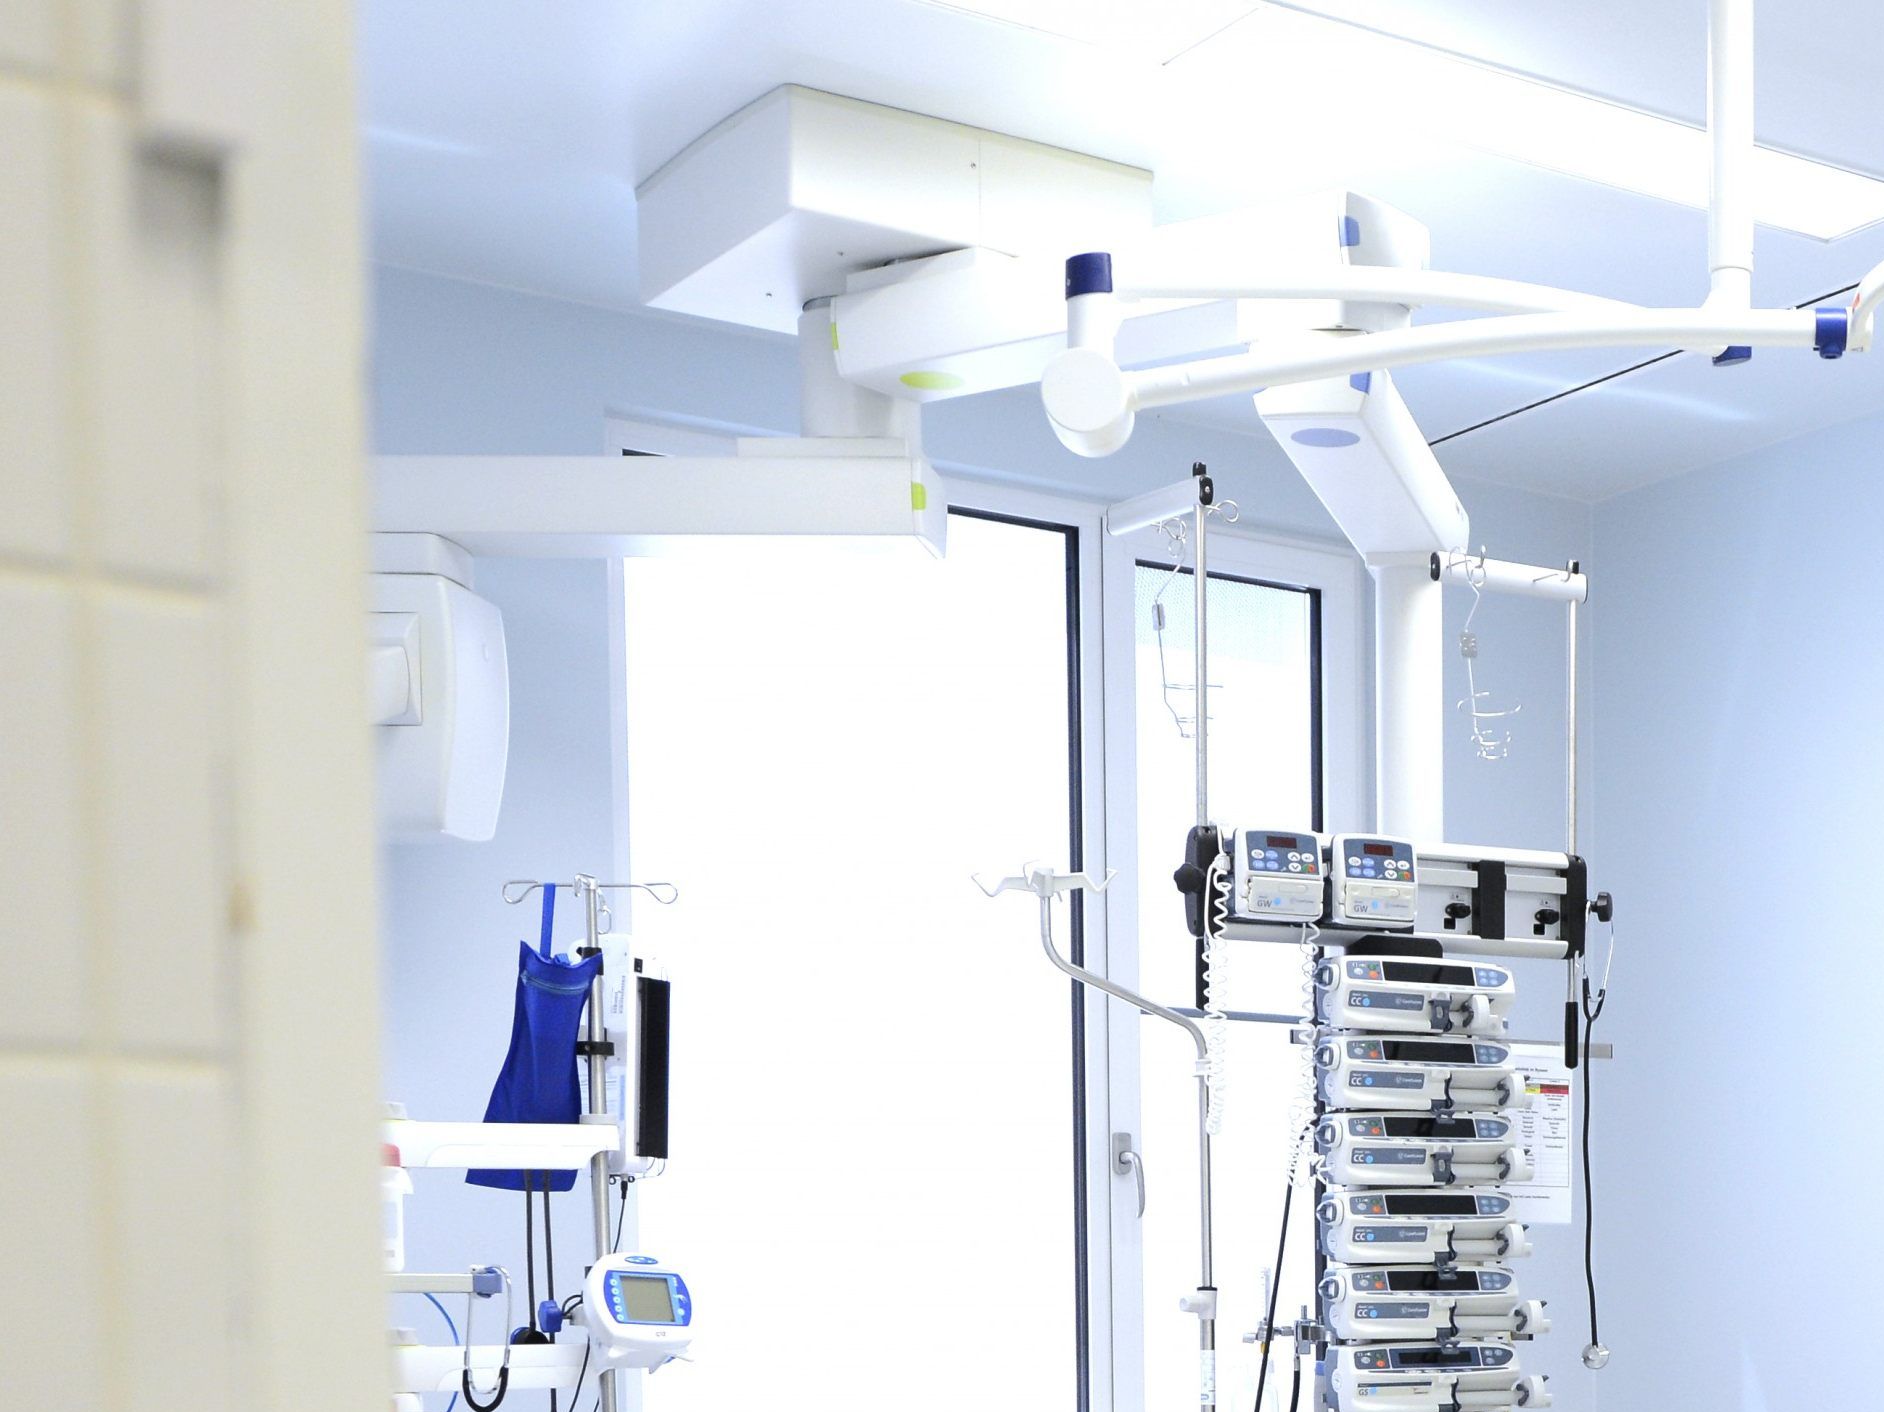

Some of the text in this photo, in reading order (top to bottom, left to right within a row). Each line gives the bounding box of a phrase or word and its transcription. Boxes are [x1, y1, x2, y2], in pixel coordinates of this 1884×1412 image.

[1257, 900, 1272, 908] GW
[1353, 905, 1368, 913] GW
[1350, 997, 1362, 1005] CC
[1351, 1077, 1362, 1085] CC
[1353, 1154, 1364, 1162] CC
[1354, 1232, 1366, 1240] CC
[1357, 1309, 1368, 1317] CC
